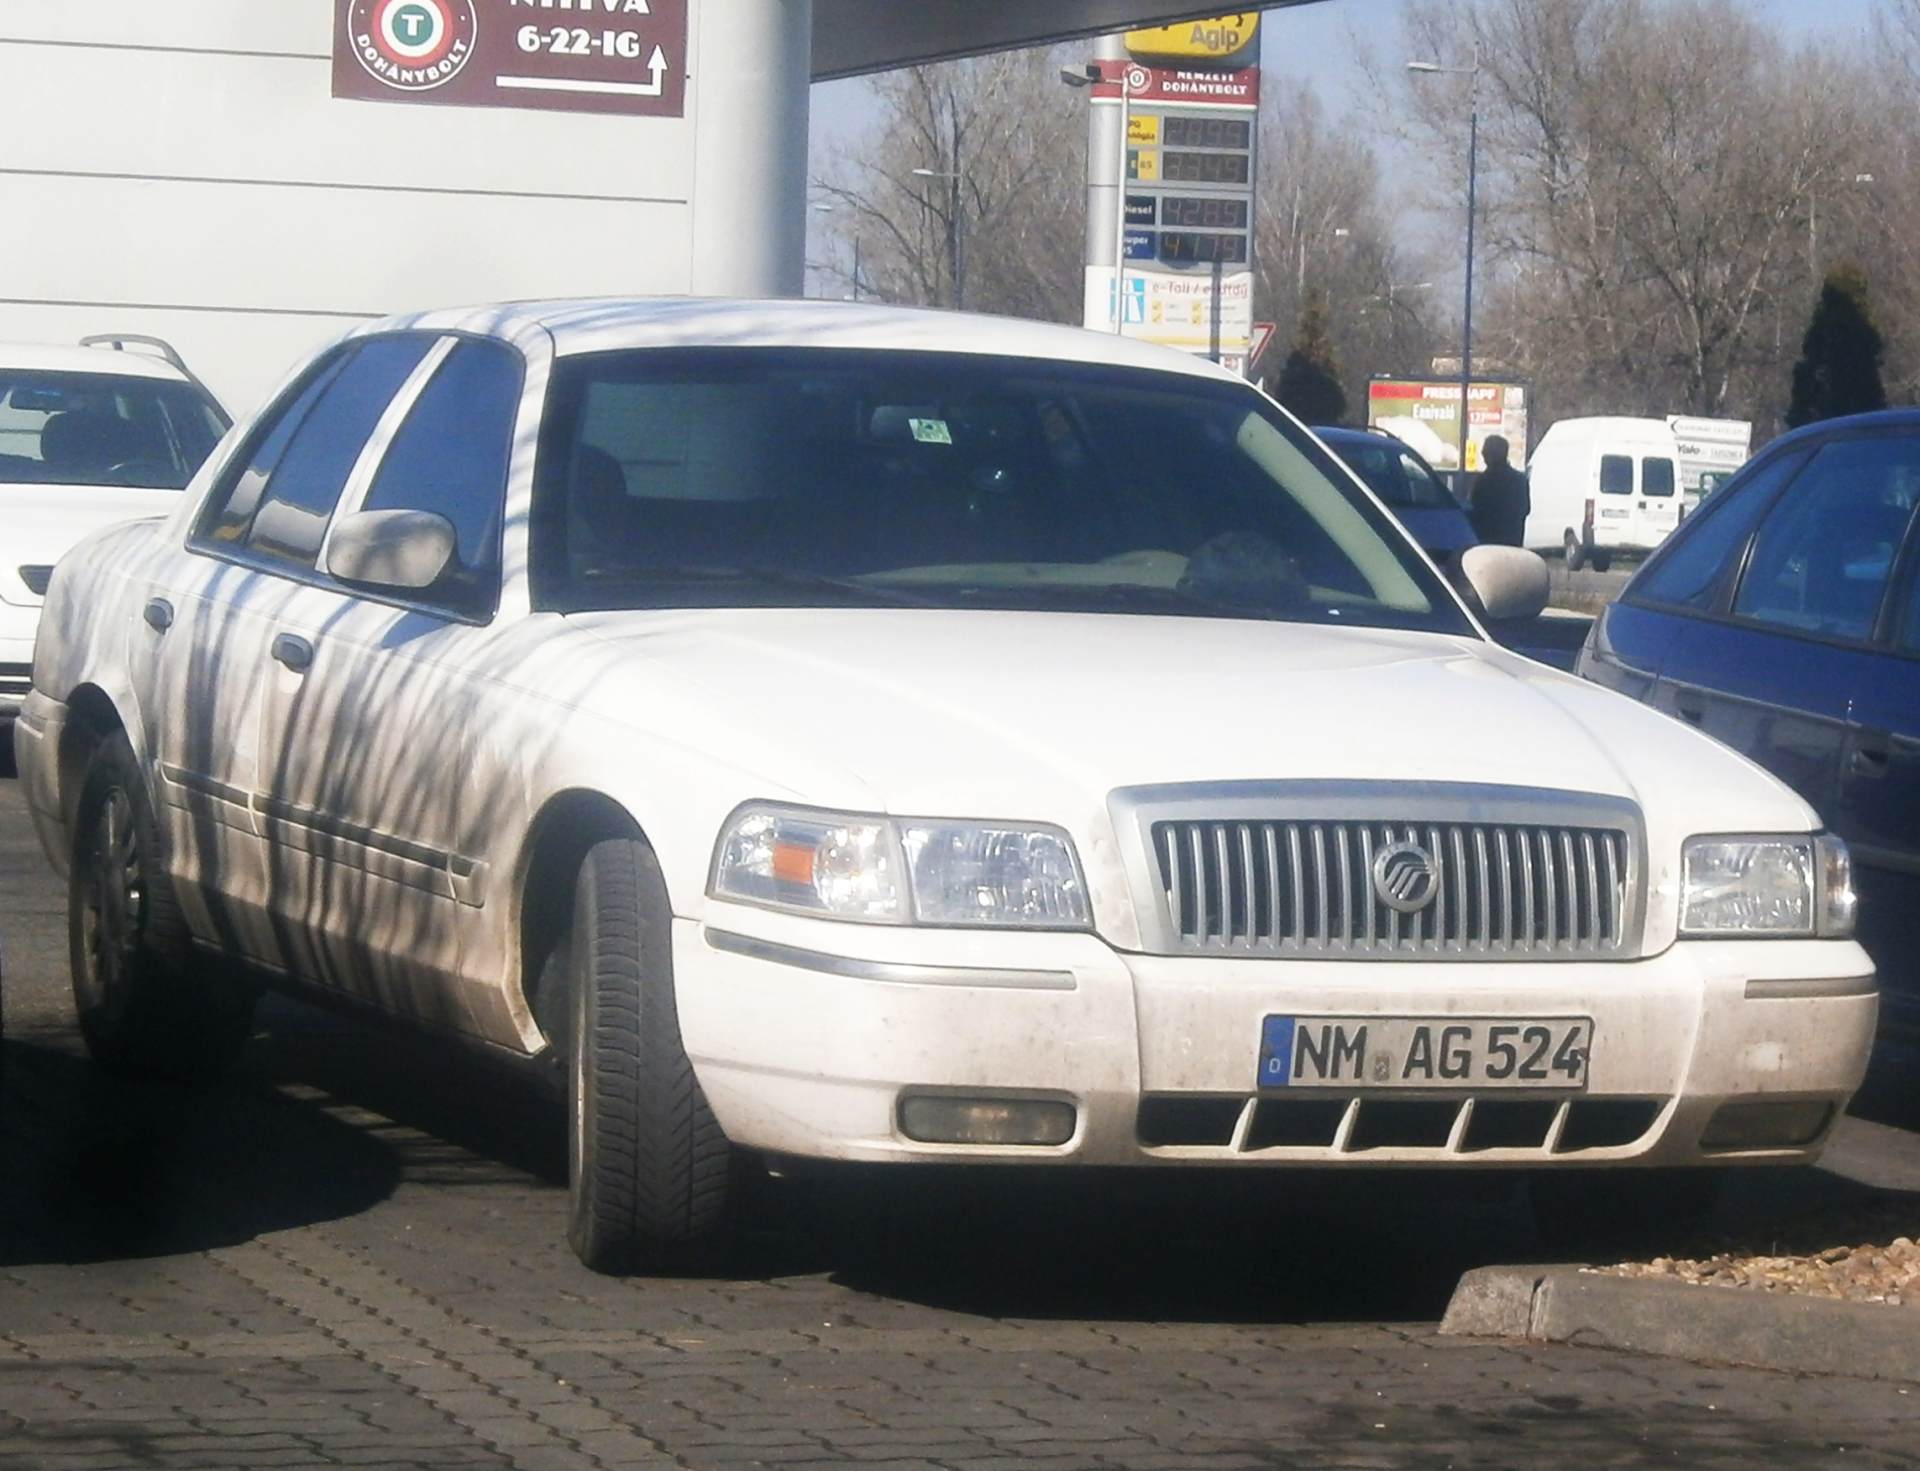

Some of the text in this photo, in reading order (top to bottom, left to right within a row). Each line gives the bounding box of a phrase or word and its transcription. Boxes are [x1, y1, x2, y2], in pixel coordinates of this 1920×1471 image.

[401, 14, 424, 36] T
[517, 25, 640, 58] 6-22-IG
[1191, 24, 1239, 51] Agip
[357, 33, 467, 83] DOHÁNYBOLT
[1293, 1025, 1583, 1079] NM AG 524
